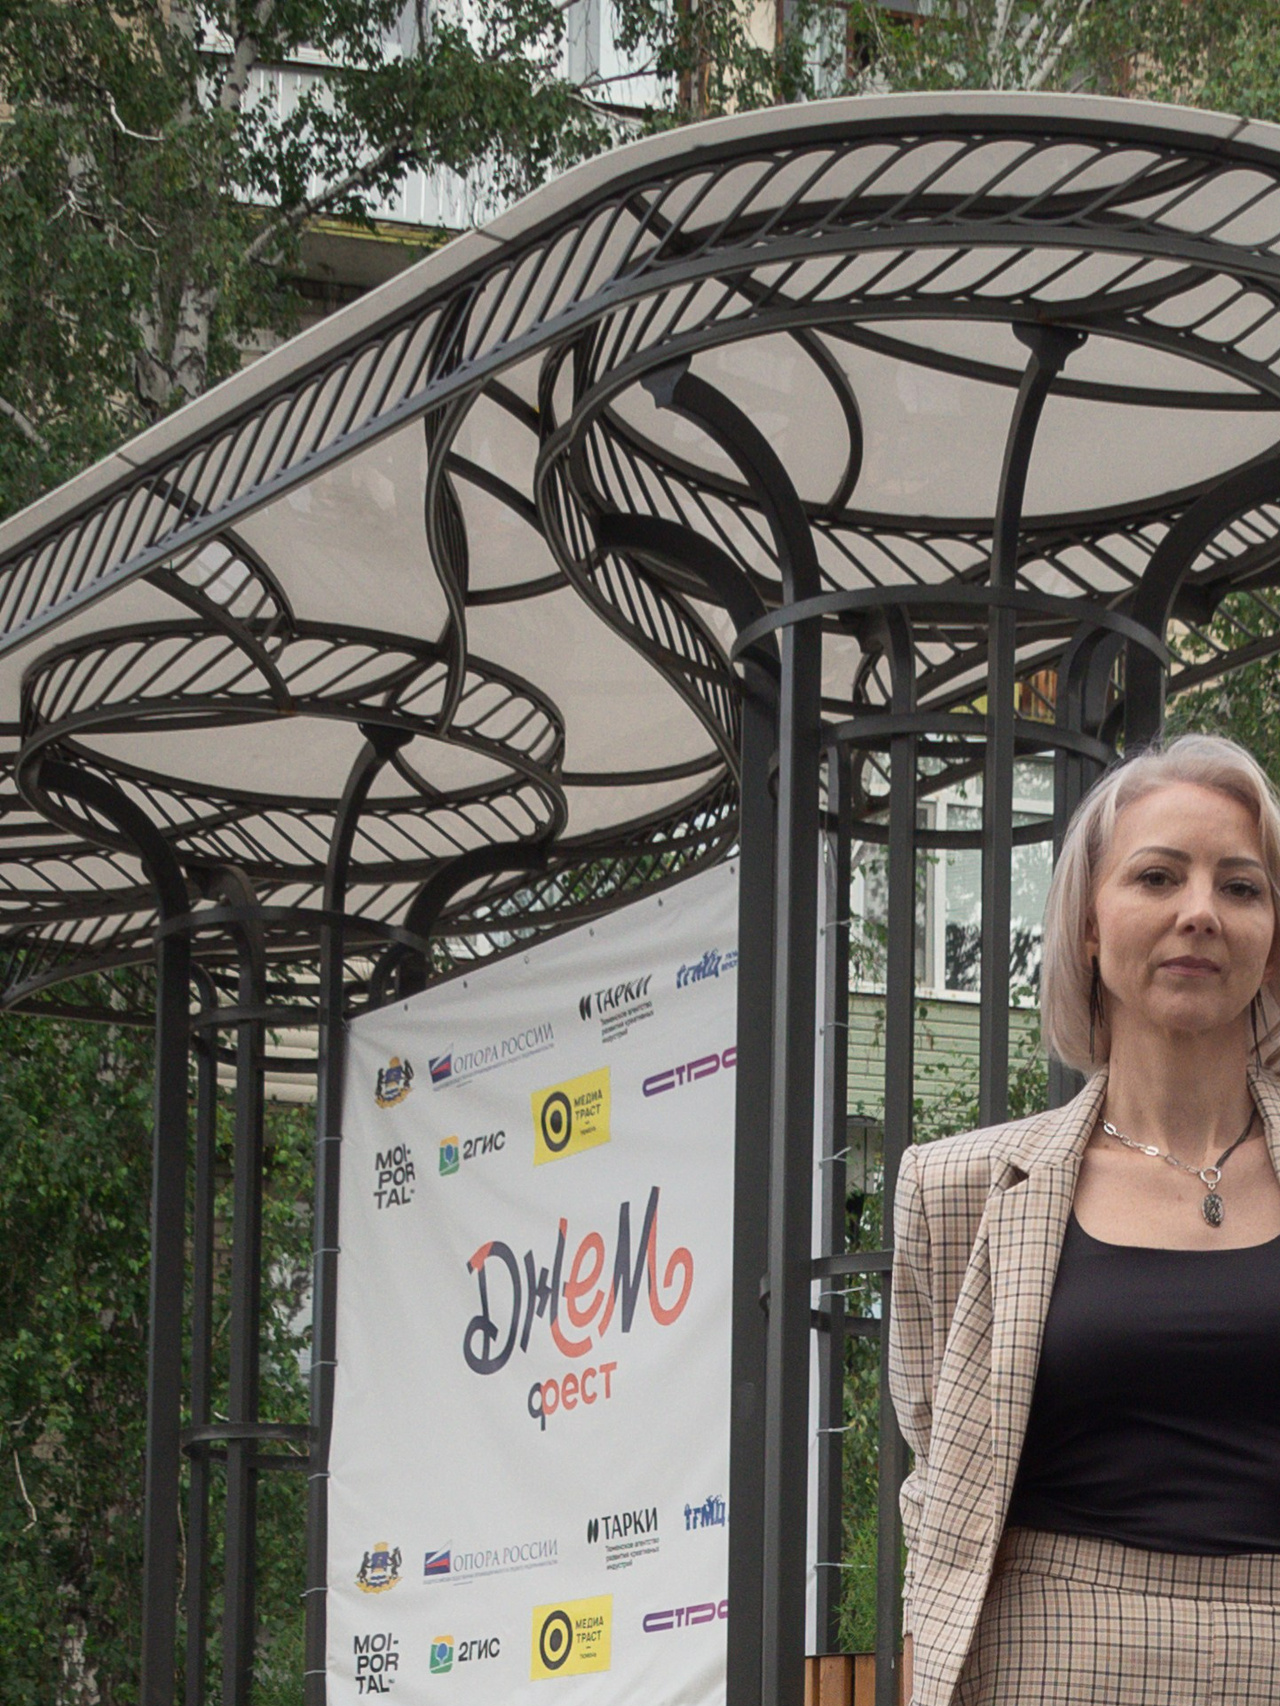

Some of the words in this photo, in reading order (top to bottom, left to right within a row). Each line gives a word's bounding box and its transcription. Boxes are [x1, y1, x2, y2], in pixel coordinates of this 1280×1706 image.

[595, 973, 652, 1014] ТАРКИ
[453, 1044, 499, 1073] ОПОРА
[501, 1021, 555, 1058] РОССИИ
[574, 1088, 603, 1107] МЕДИА
[575, 1103, 601, 1121] ТРАСТ
[463, 1130, 506, 1160] 2ГИС
[378, 1162, 415, 1189] POR
[601, 1507, 658, 1540] ТАРКИ
[453, 1549, 500, 1572] ОПОРА
[503, 1538, 558, 1564] РОССИИ
[575, 1616, 604, 1629] МЕДИА
[576, 1629, 602, 1643] ТРАСТ
[458, 1637, 500, 1662] 2ГИС
[357, 1652, 399, 1674] POR
